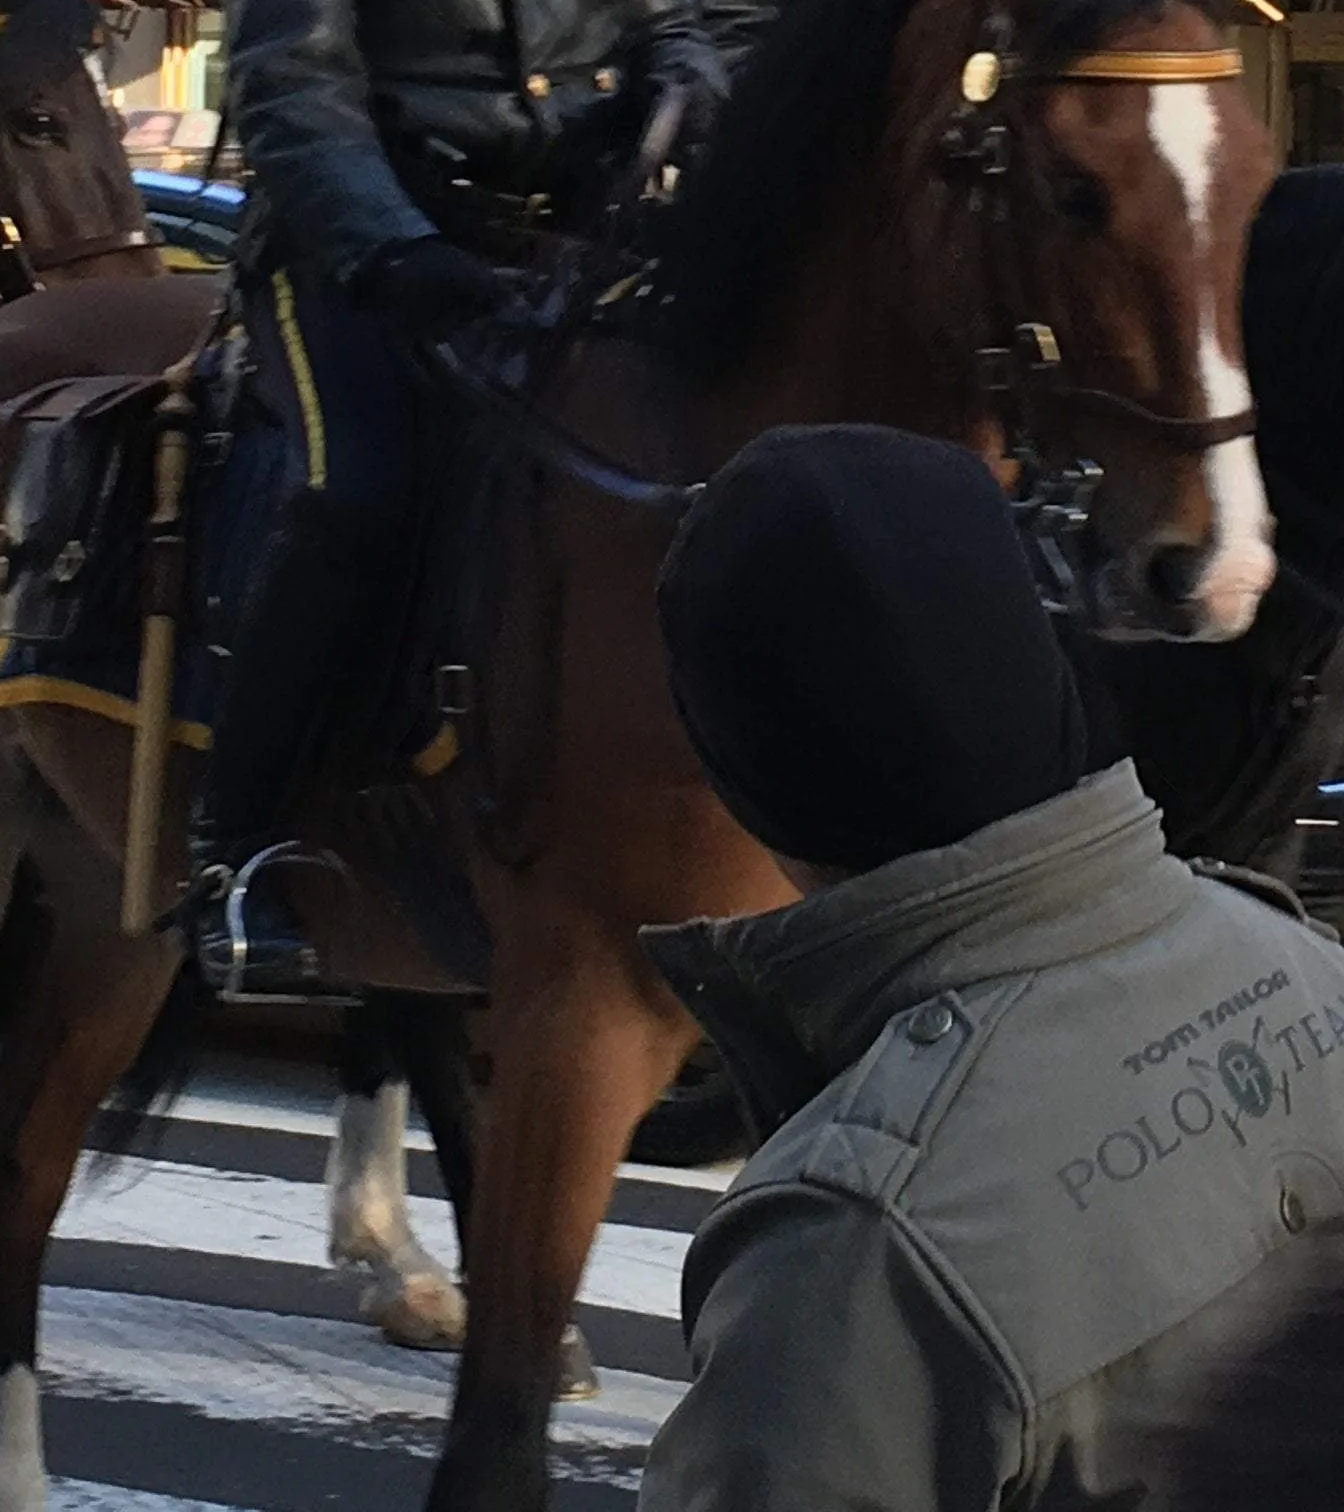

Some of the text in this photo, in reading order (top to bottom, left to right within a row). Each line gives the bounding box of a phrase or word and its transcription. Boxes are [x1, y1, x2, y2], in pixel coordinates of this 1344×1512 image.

[1121, 967, 1292, 1076] TOM TAILOR
[1055, 1086, 1216, 1212] POLO
